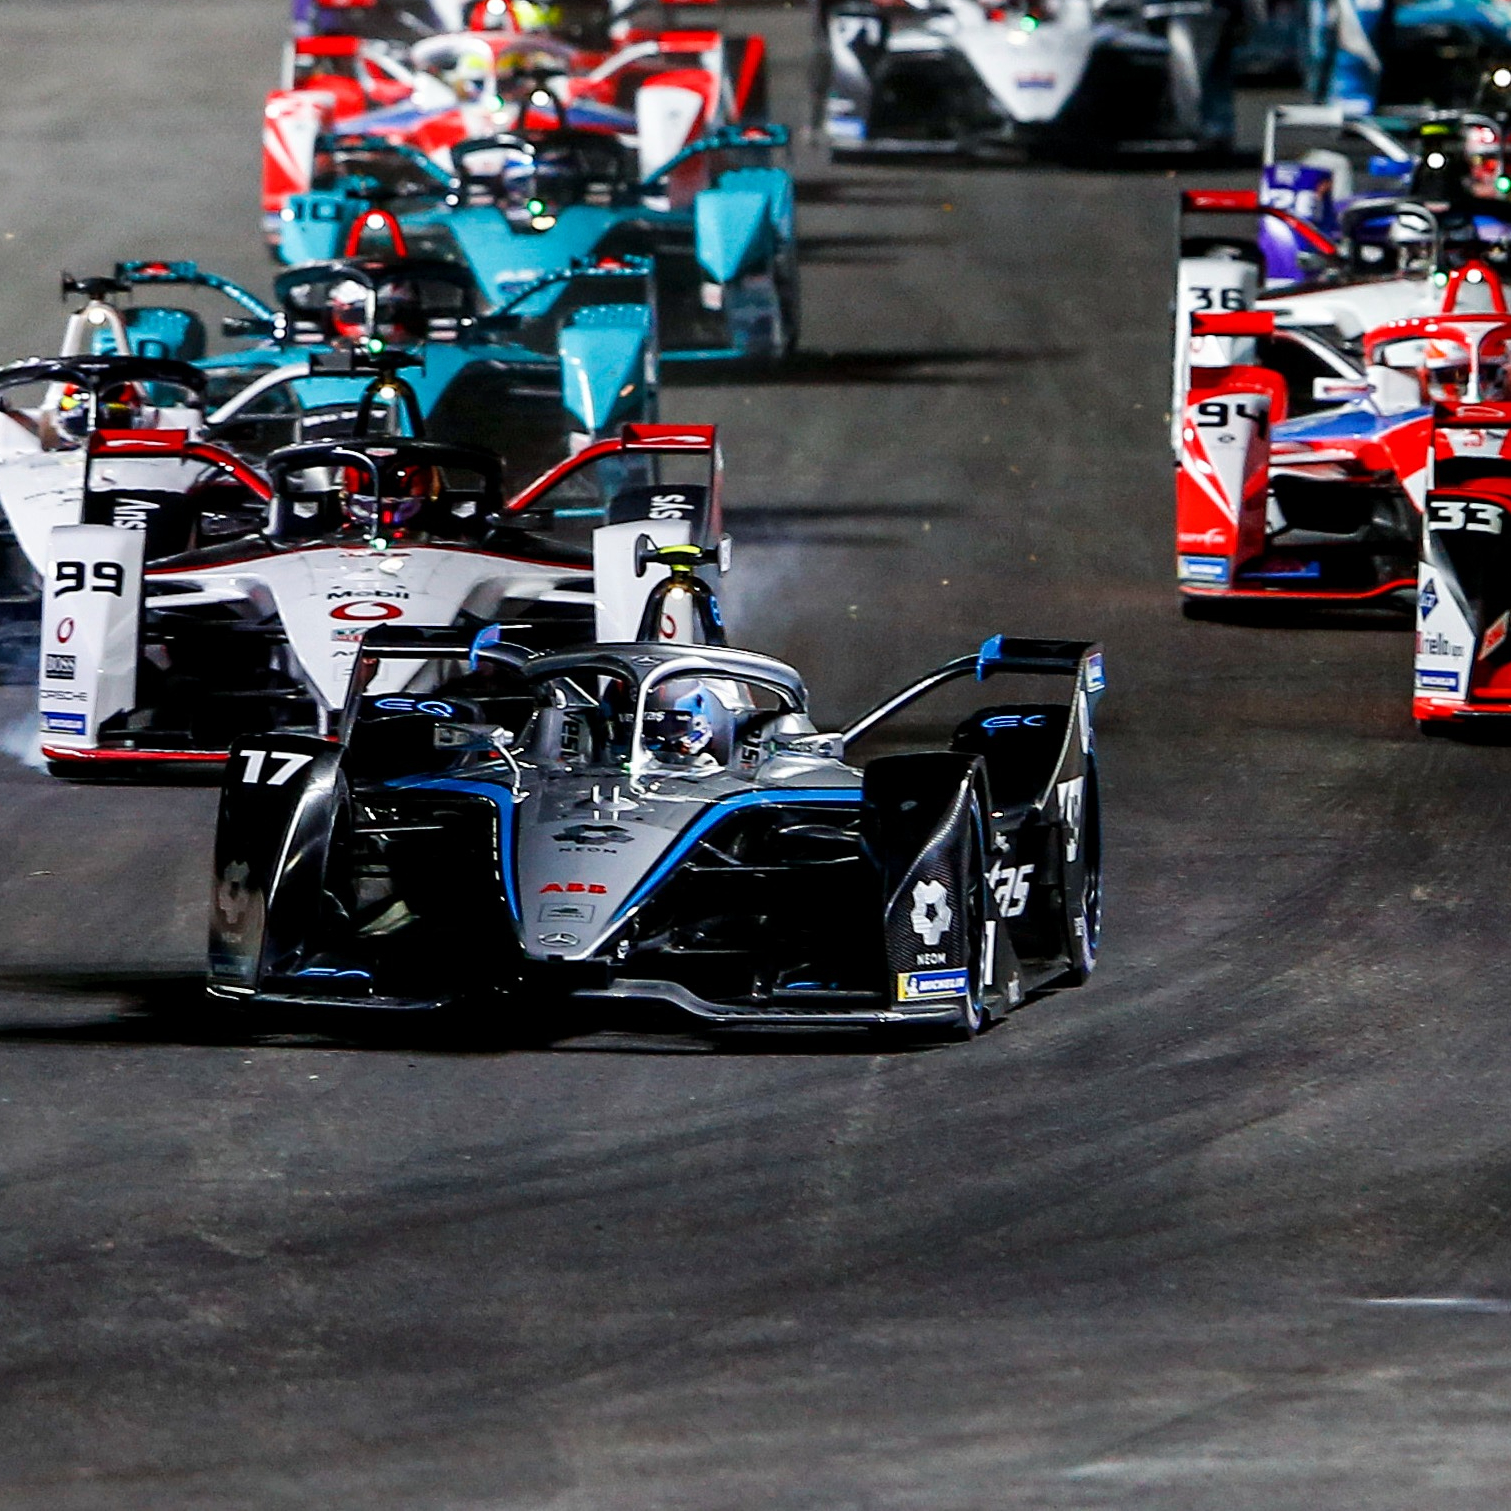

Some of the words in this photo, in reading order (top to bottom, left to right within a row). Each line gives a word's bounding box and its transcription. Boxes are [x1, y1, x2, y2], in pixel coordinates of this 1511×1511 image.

[1189, 287, 1248, 311] 36
[1197, 402, 1267, 439] 94
[113, 497, 160, 530] Ans
[648, 493, 695, 520] sys
[1429, 501, 1504, 535] 33
[54, 561, 125, 597] 99
[327, 590, 409, 600] Mobil
[240, 750, 313, 786] 17
[540, 883, 608, 895] ABB
[916, 953, 947, 966] NEOM
